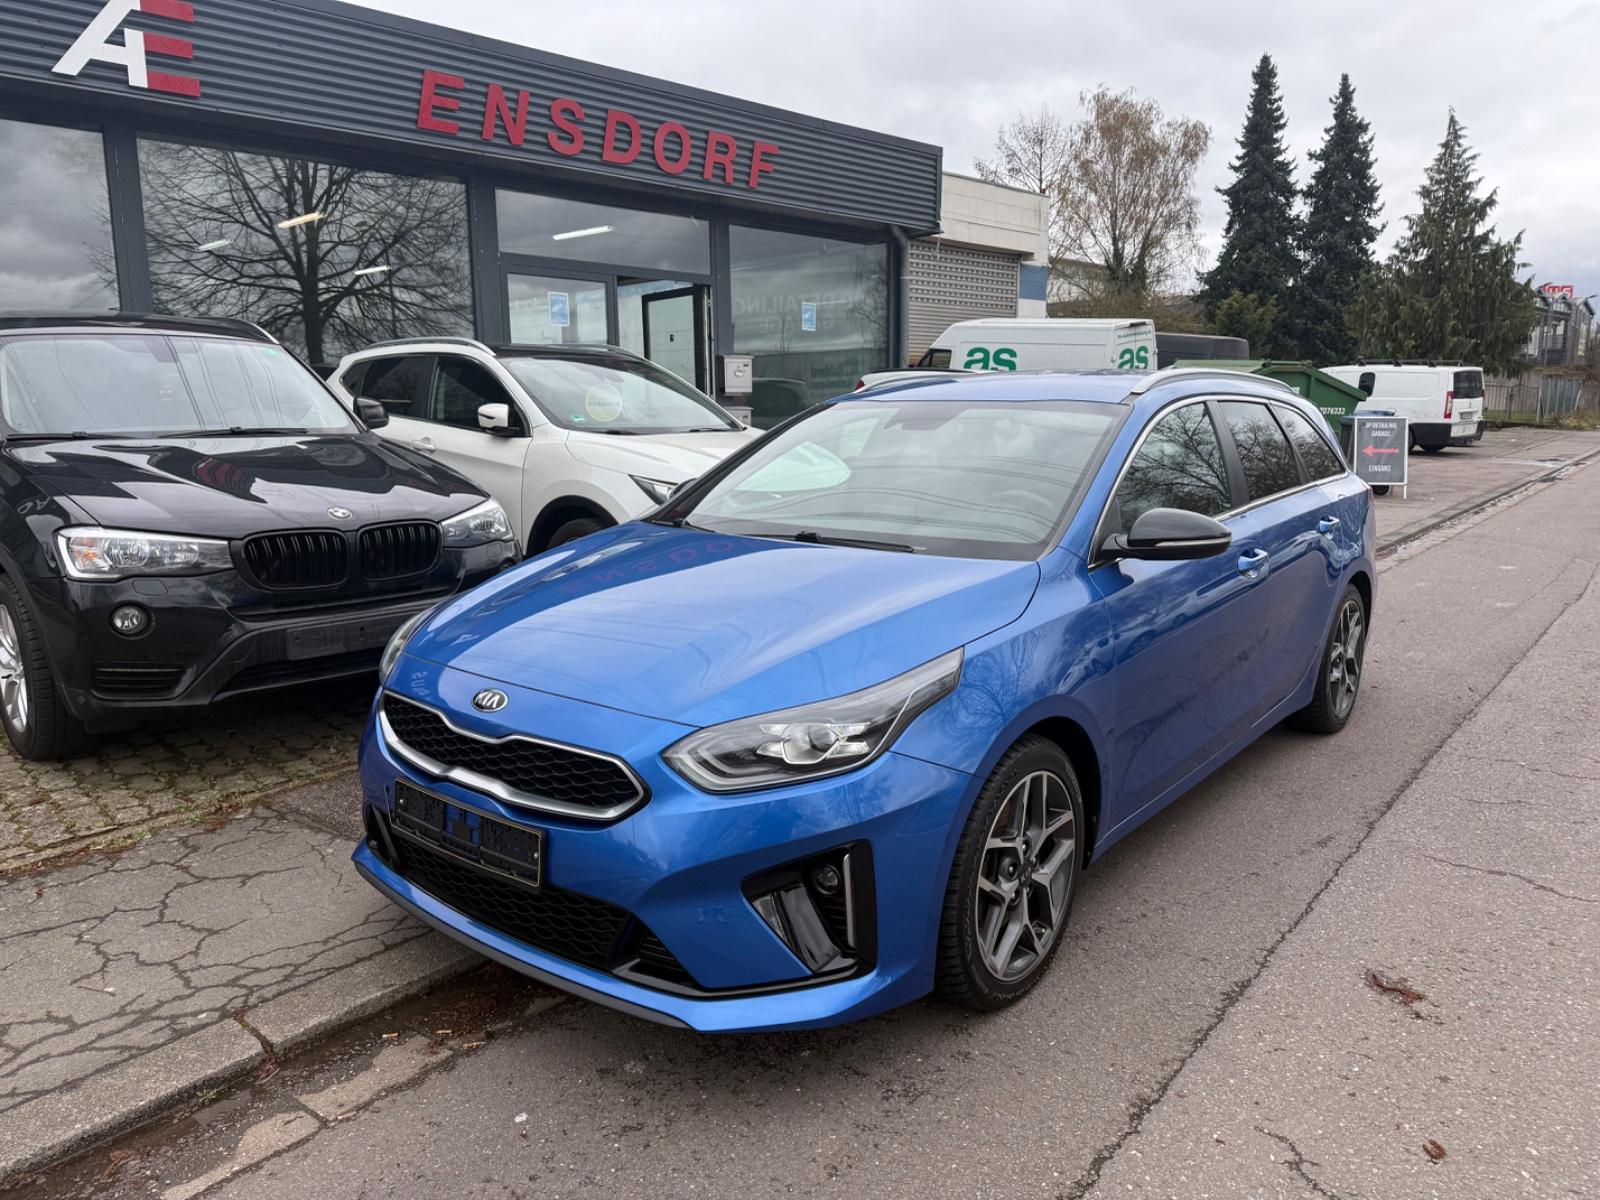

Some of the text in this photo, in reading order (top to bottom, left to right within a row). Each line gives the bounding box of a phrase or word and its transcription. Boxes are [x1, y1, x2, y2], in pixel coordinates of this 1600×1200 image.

[417, 69, 780, 188] ENSDORF
[963, 346, 1017, 371] as
[1117, 345, 1149, 370] as
[475, 691, 500, 708] KIA
